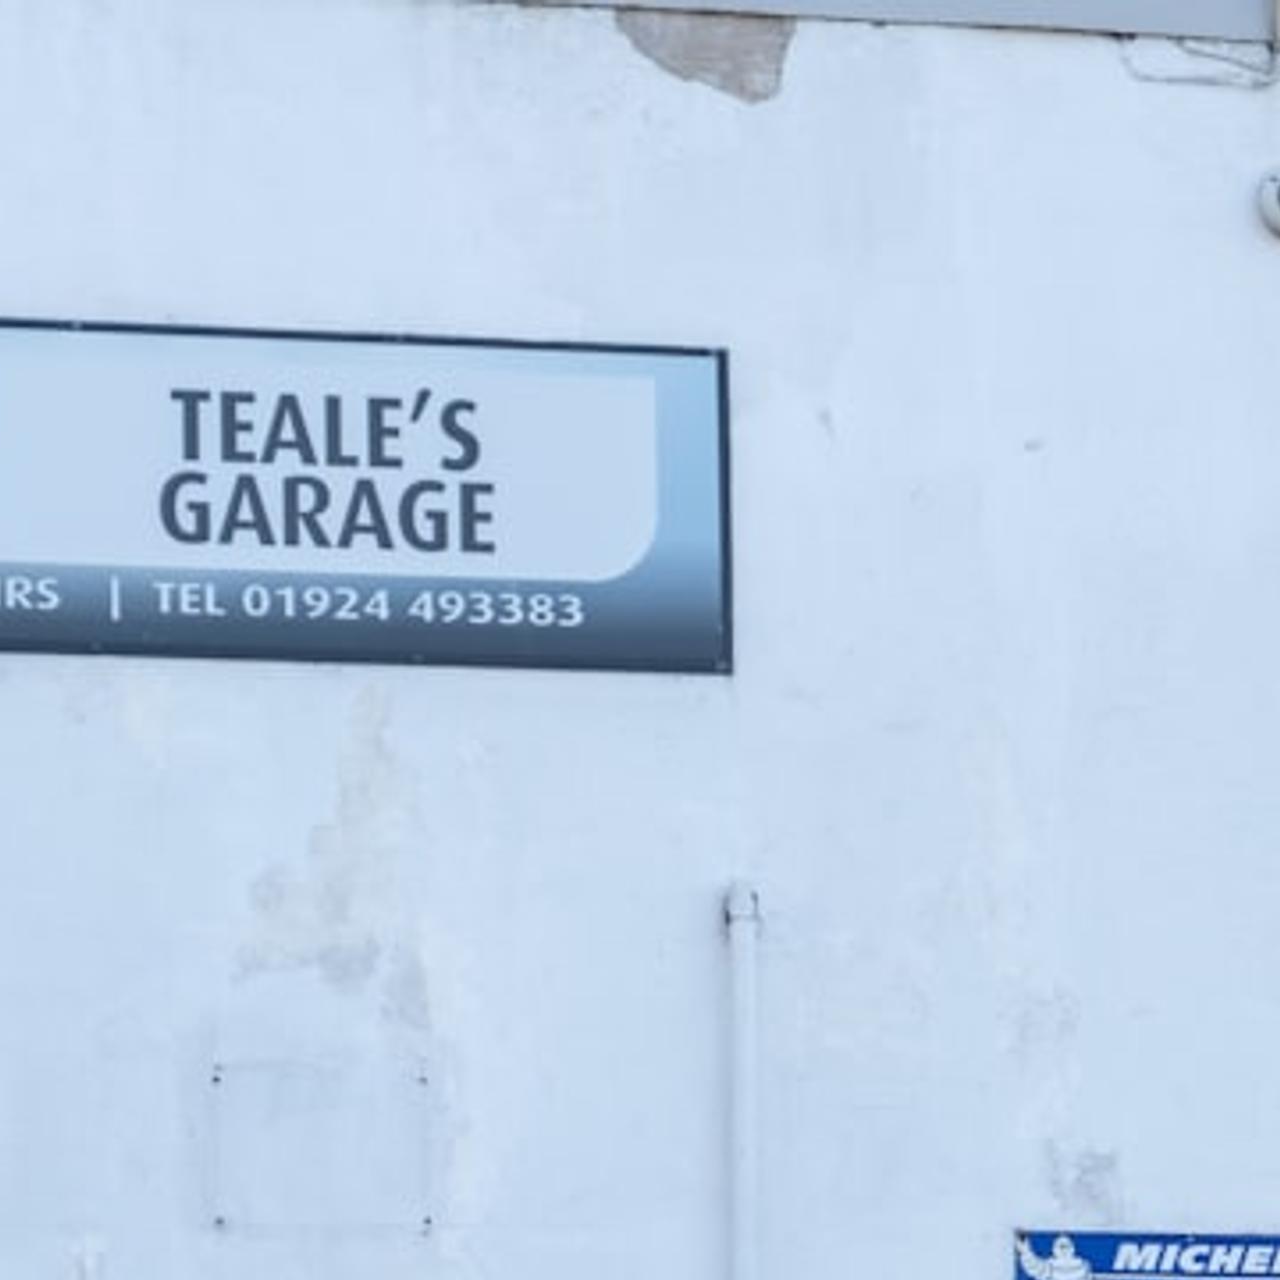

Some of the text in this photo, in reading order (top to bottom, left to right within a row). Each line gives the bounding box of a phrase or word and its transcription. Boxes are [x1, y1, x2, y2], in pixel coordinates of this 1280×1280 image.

[170, 388, 481, 471] TEALE'S
[159, 471, 496, 553] GARAGE
[153, 582, 227, 616] TEL
[242, 584, 391, 620] 01924
[409, 594, 585, 627] 493383
